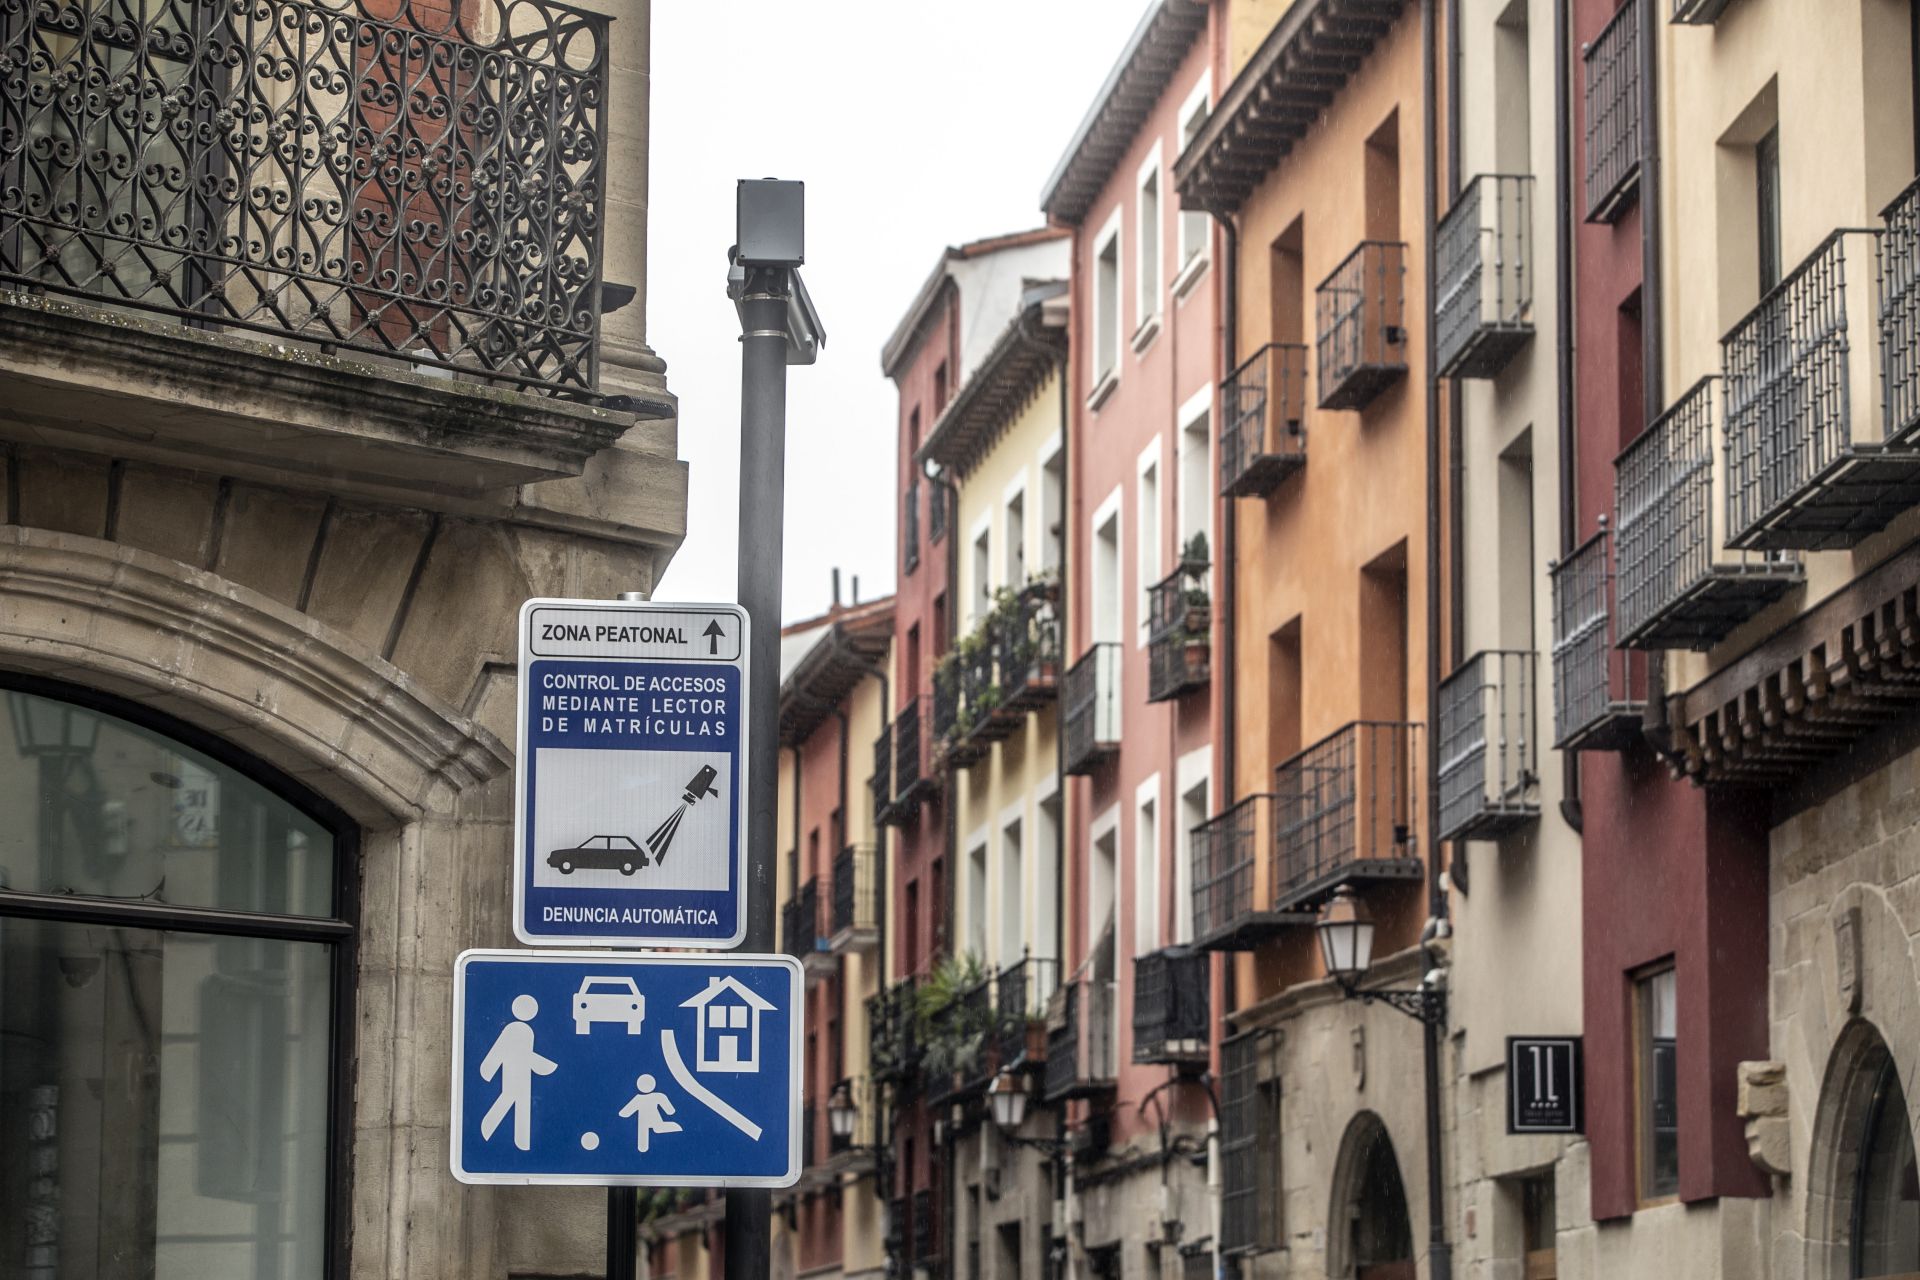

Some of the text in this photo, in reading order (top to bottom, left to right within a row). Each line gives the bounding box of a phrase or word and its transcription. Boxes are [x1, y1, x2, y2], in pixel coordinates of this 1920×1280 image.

[542, 624, 688, 644] ZONA PEATONAL
[543, 674, 726, 693] CONTROL DE ACCESOS
[542, 695, 726, 715] MEDIANTE LECTOR
[542, 716, 725, 736] DE MATRÍCULAS
[543, 905, 719, 925] DENUNCIA AUTOMÁTICA
